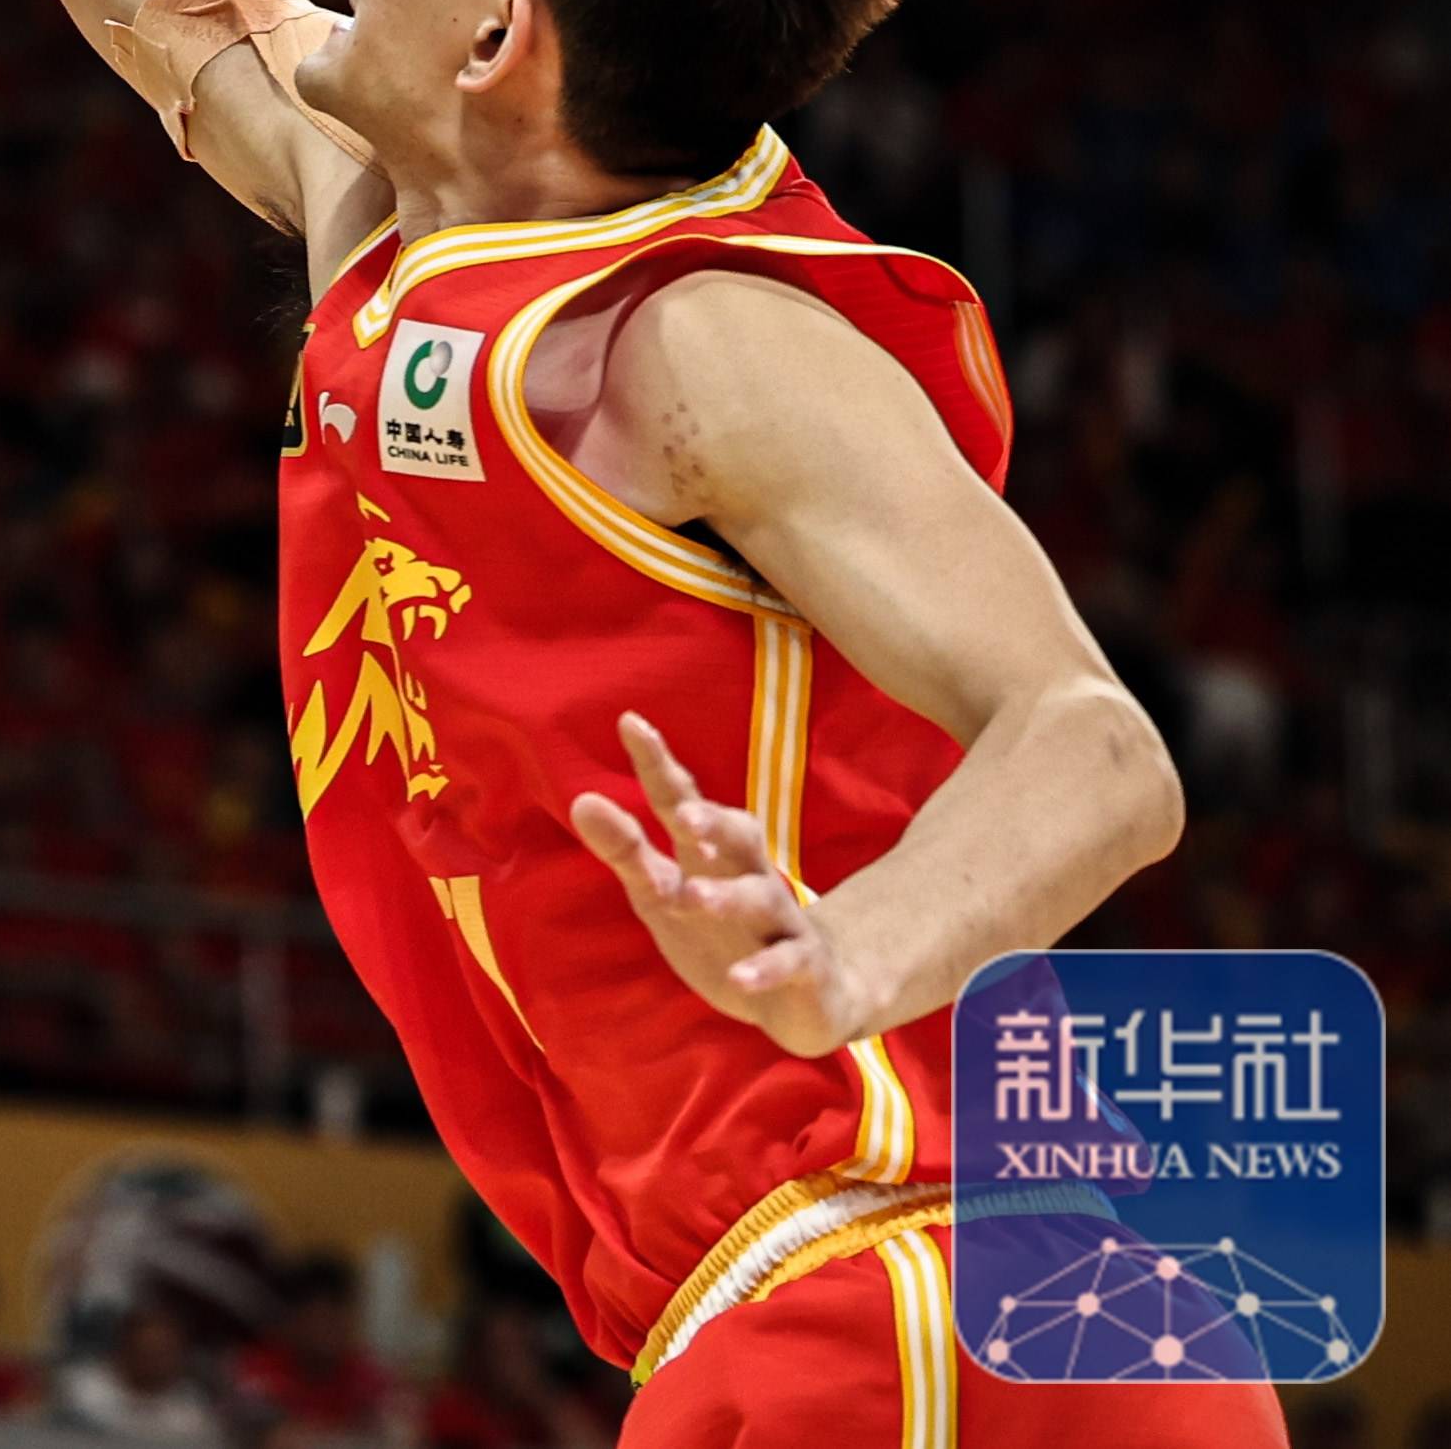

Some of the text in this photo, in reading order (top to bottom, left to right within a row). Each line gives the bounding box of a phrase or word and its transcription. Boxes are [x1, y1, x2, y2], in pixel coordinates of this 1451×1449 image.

[386, 419, 466, 450] 中国人寿
[388, 445, 469, 467] CHINA LIFE
